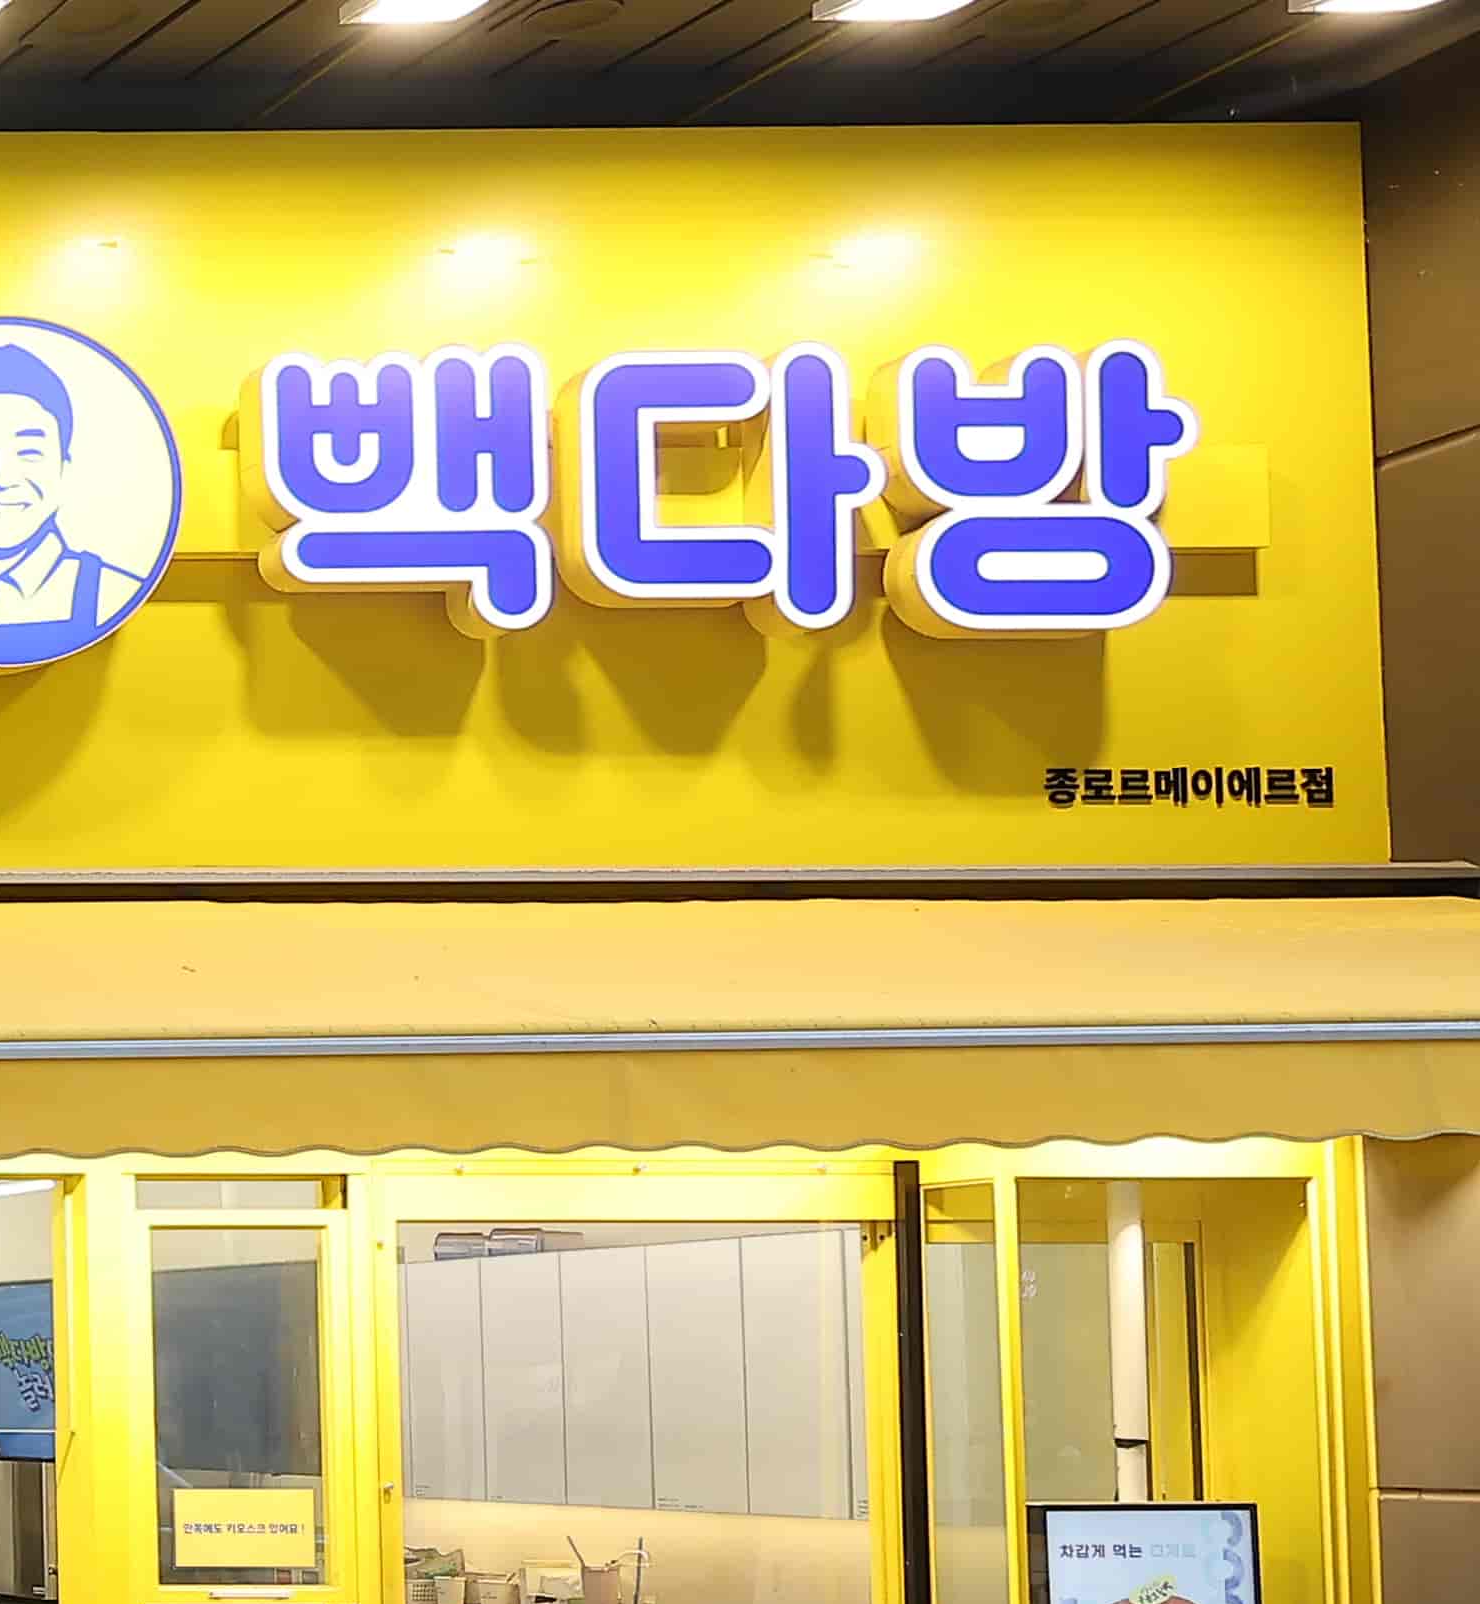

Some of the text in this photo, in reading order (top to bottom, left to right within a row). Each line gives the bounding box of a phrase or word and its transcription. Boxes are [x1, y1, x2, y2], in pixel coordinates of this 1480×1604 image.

[259, 338, 1199, 632] 빽다방
[1044, 767, 1333, 807] 종로르메이에르점
[226, 1523, 265, 1535] 키오스크
[1059, 1544, 1105, 1559] 차갑게
[1113, 1544, 1143, 1559] 먹는
